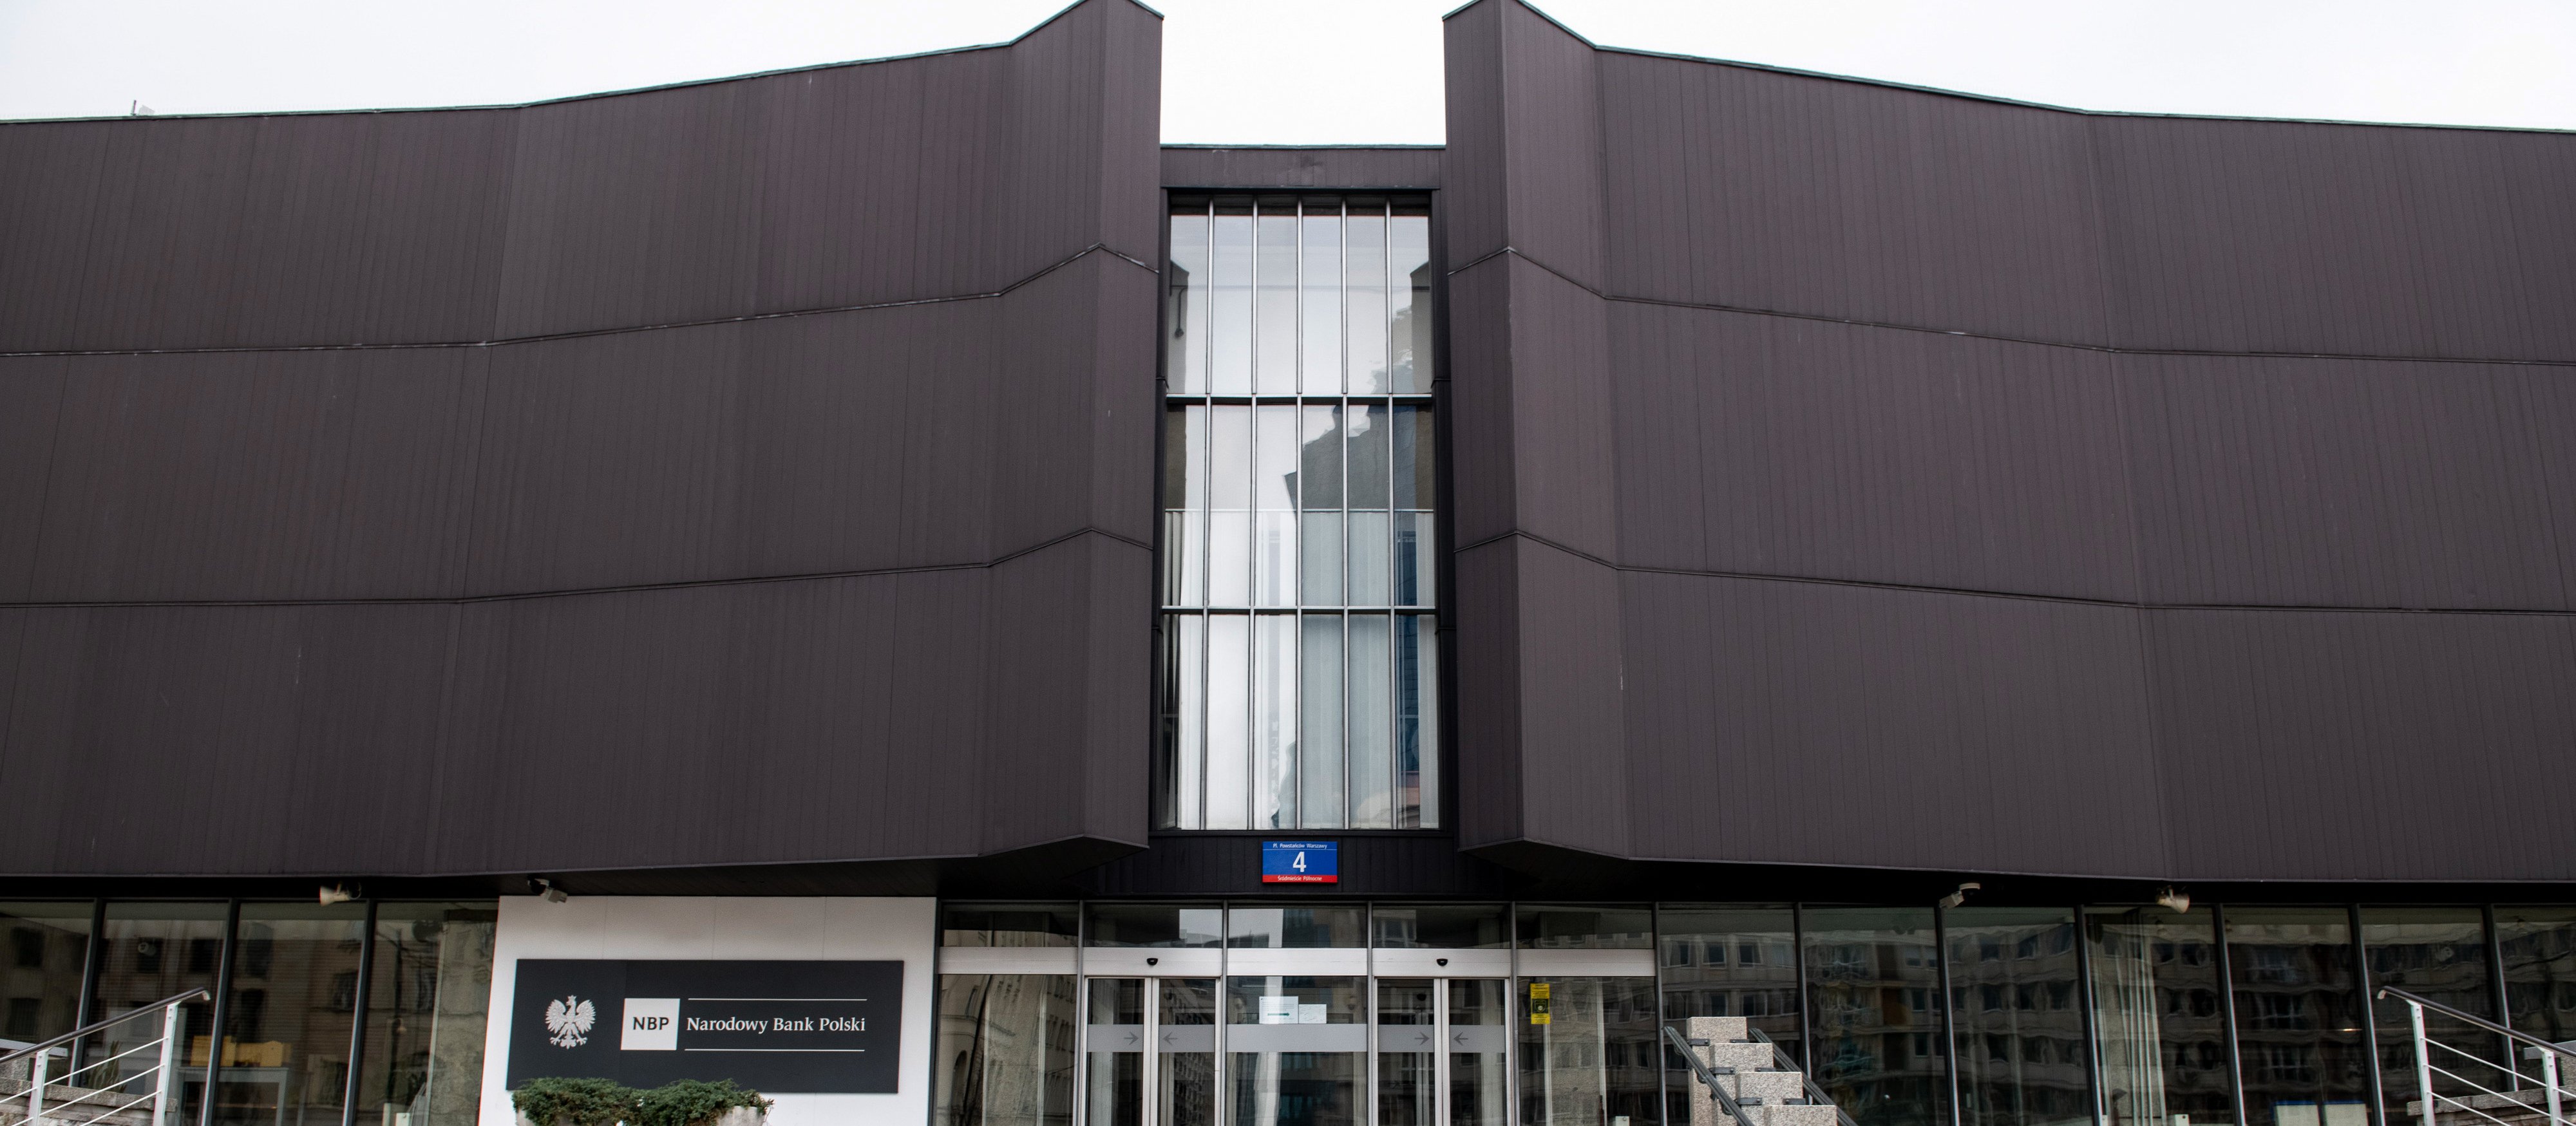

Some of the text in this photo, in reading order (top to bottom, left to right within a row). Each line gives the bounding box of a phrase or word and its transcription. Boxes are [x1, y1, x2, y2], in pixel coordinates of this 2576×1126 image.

[1293, 851, 1307, 872] 4
[632, 1016, 670, 1031] NBP
[686, 1016, 866, 1035] Narodowy Bank Polski
